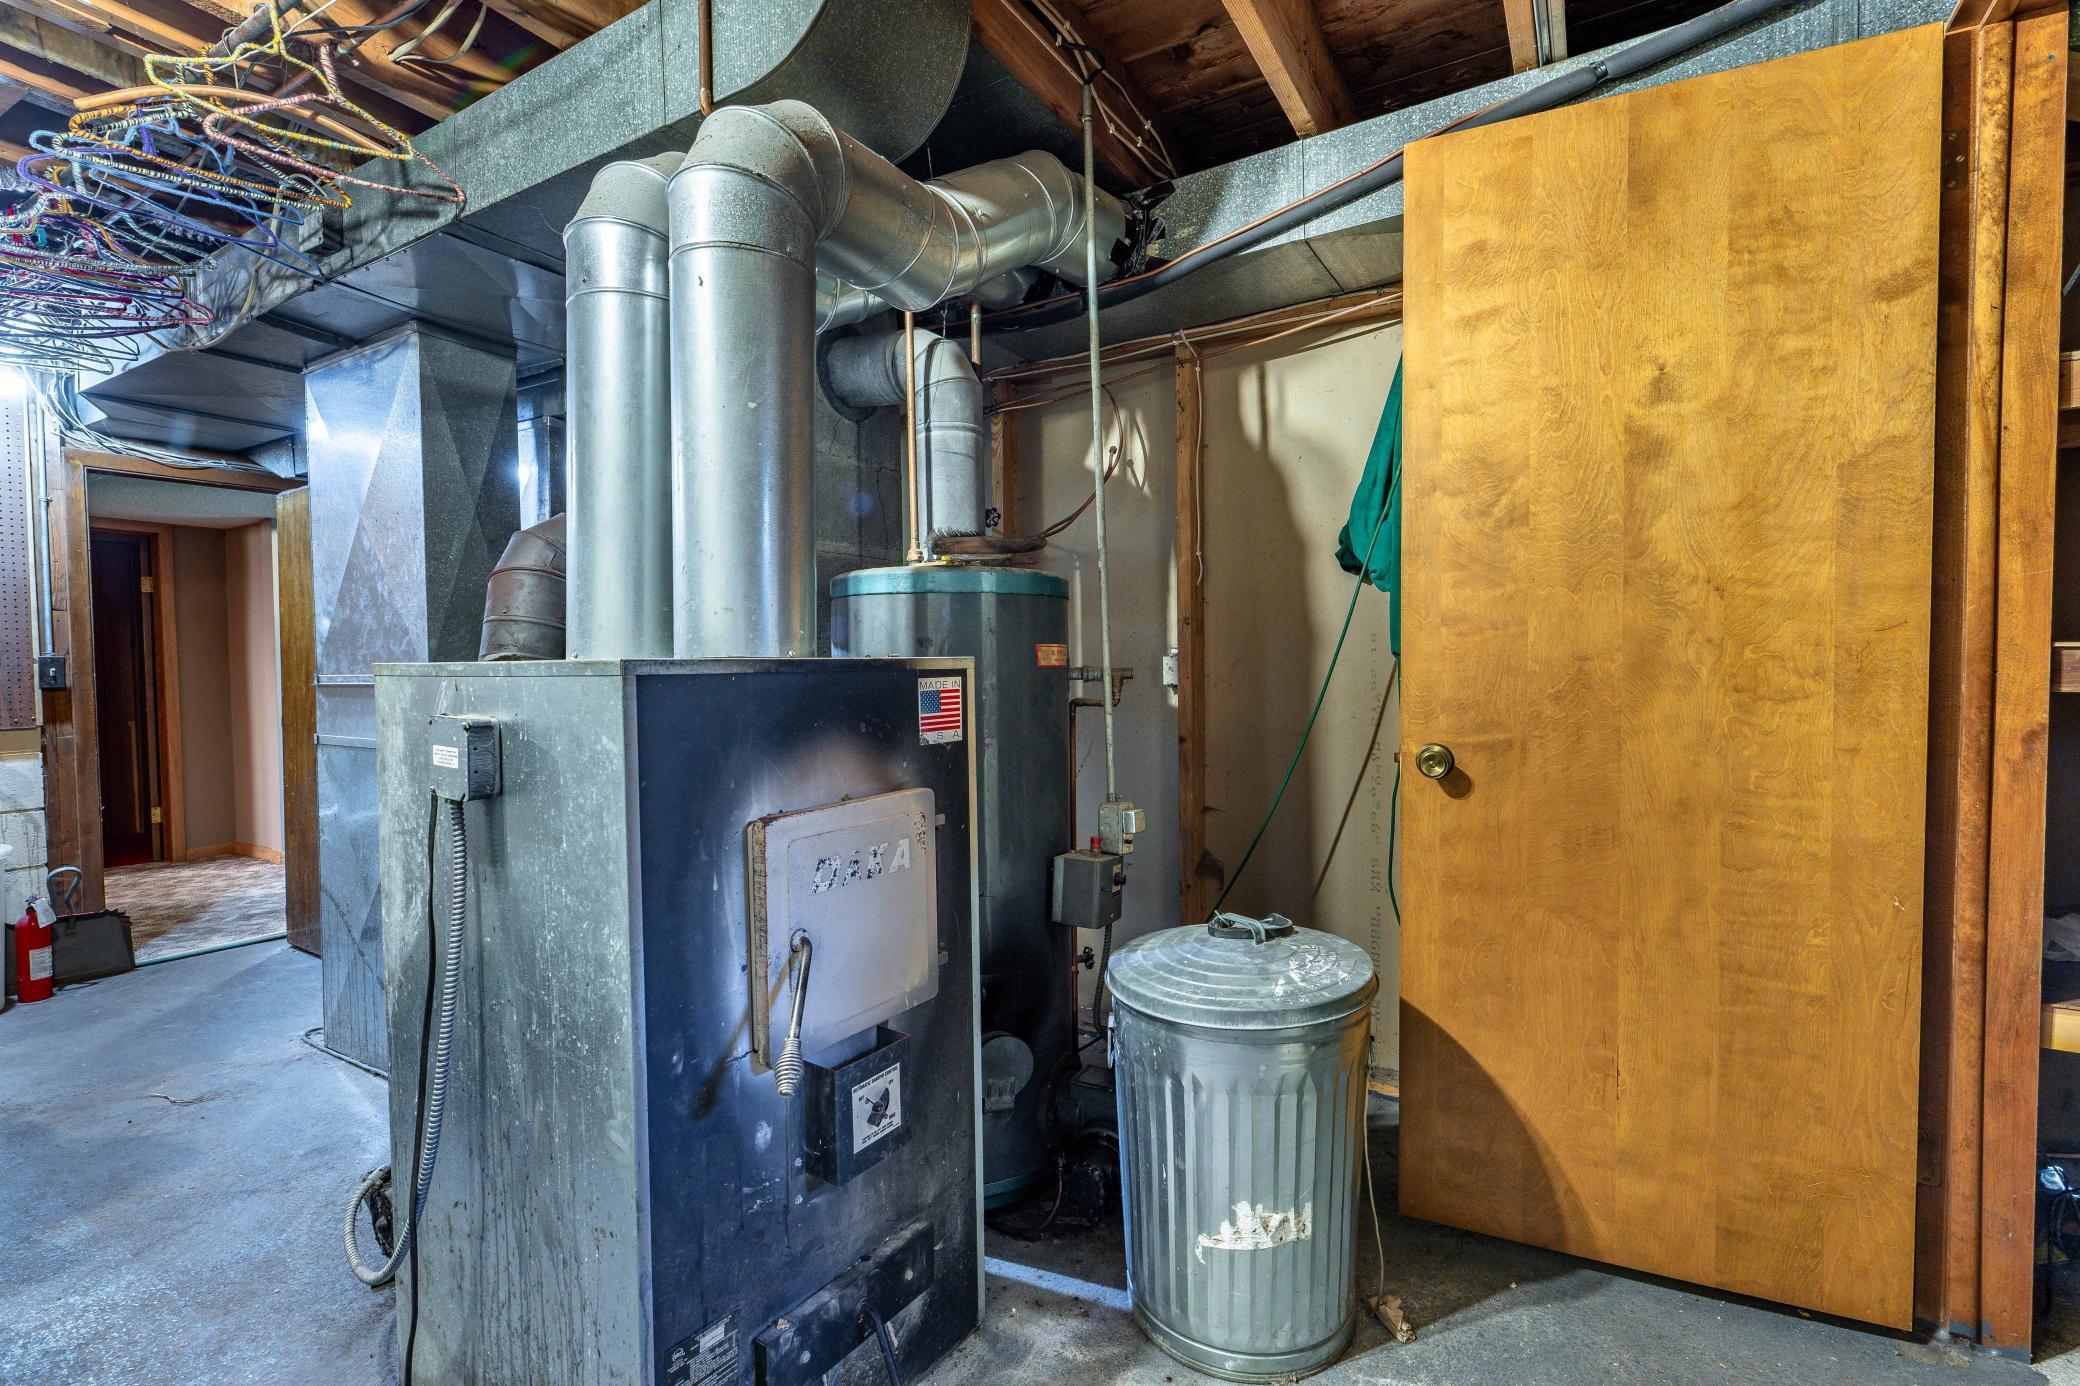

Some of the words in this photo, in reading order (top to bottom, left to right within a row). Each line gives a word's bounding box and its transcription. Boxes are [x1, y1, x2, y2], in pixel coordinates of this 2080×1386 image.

[920, 680, 948, 690] MADE
[951, 680, 961, 688] IN
[809, 838, 912, 896] DAKA
